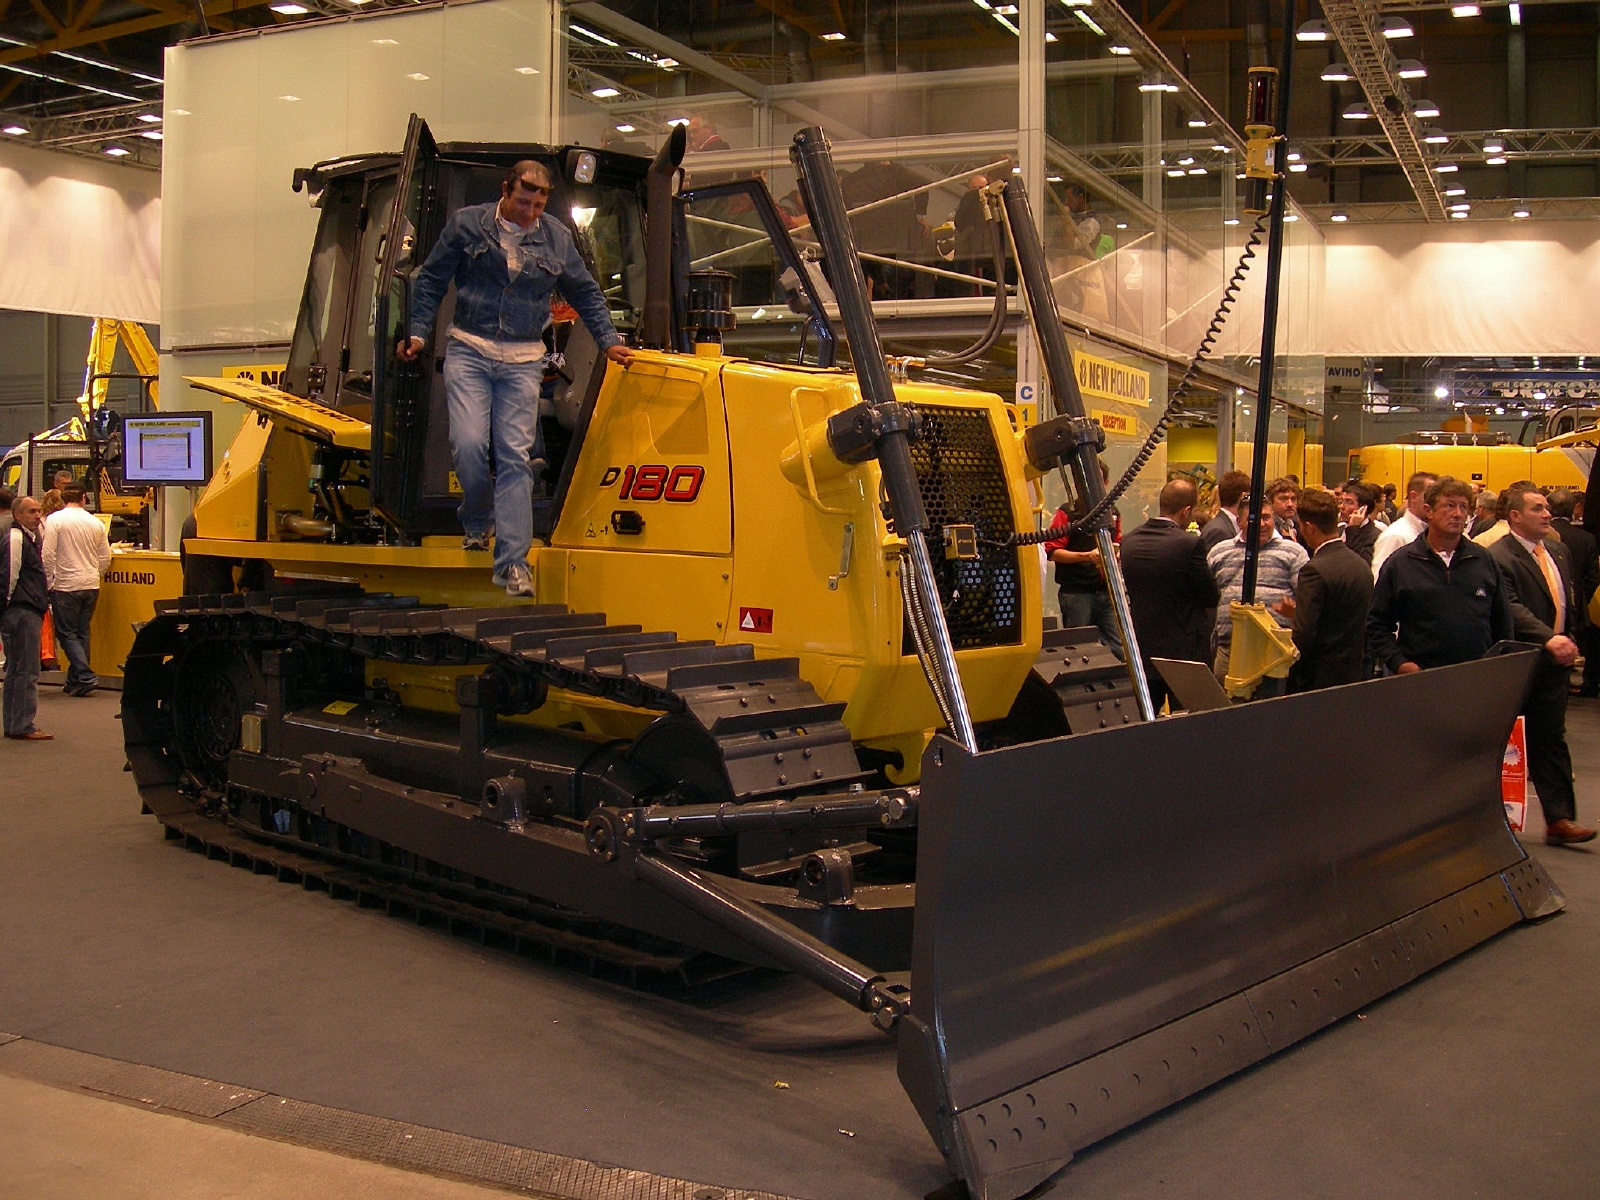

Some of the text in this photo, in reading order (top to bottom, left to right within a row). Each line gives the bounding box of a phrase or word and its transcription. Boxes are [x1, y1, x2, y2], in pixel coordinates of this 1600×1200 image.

[1089, 361, 1146, 400] NEW HOLLAND
[1020, 386, 1033, 400] C
[1022, 408, 1028, 421] 1
[1102, 414, 1127, 431] RECEPTION
[104, 571, 156, 585] HOLLAND
